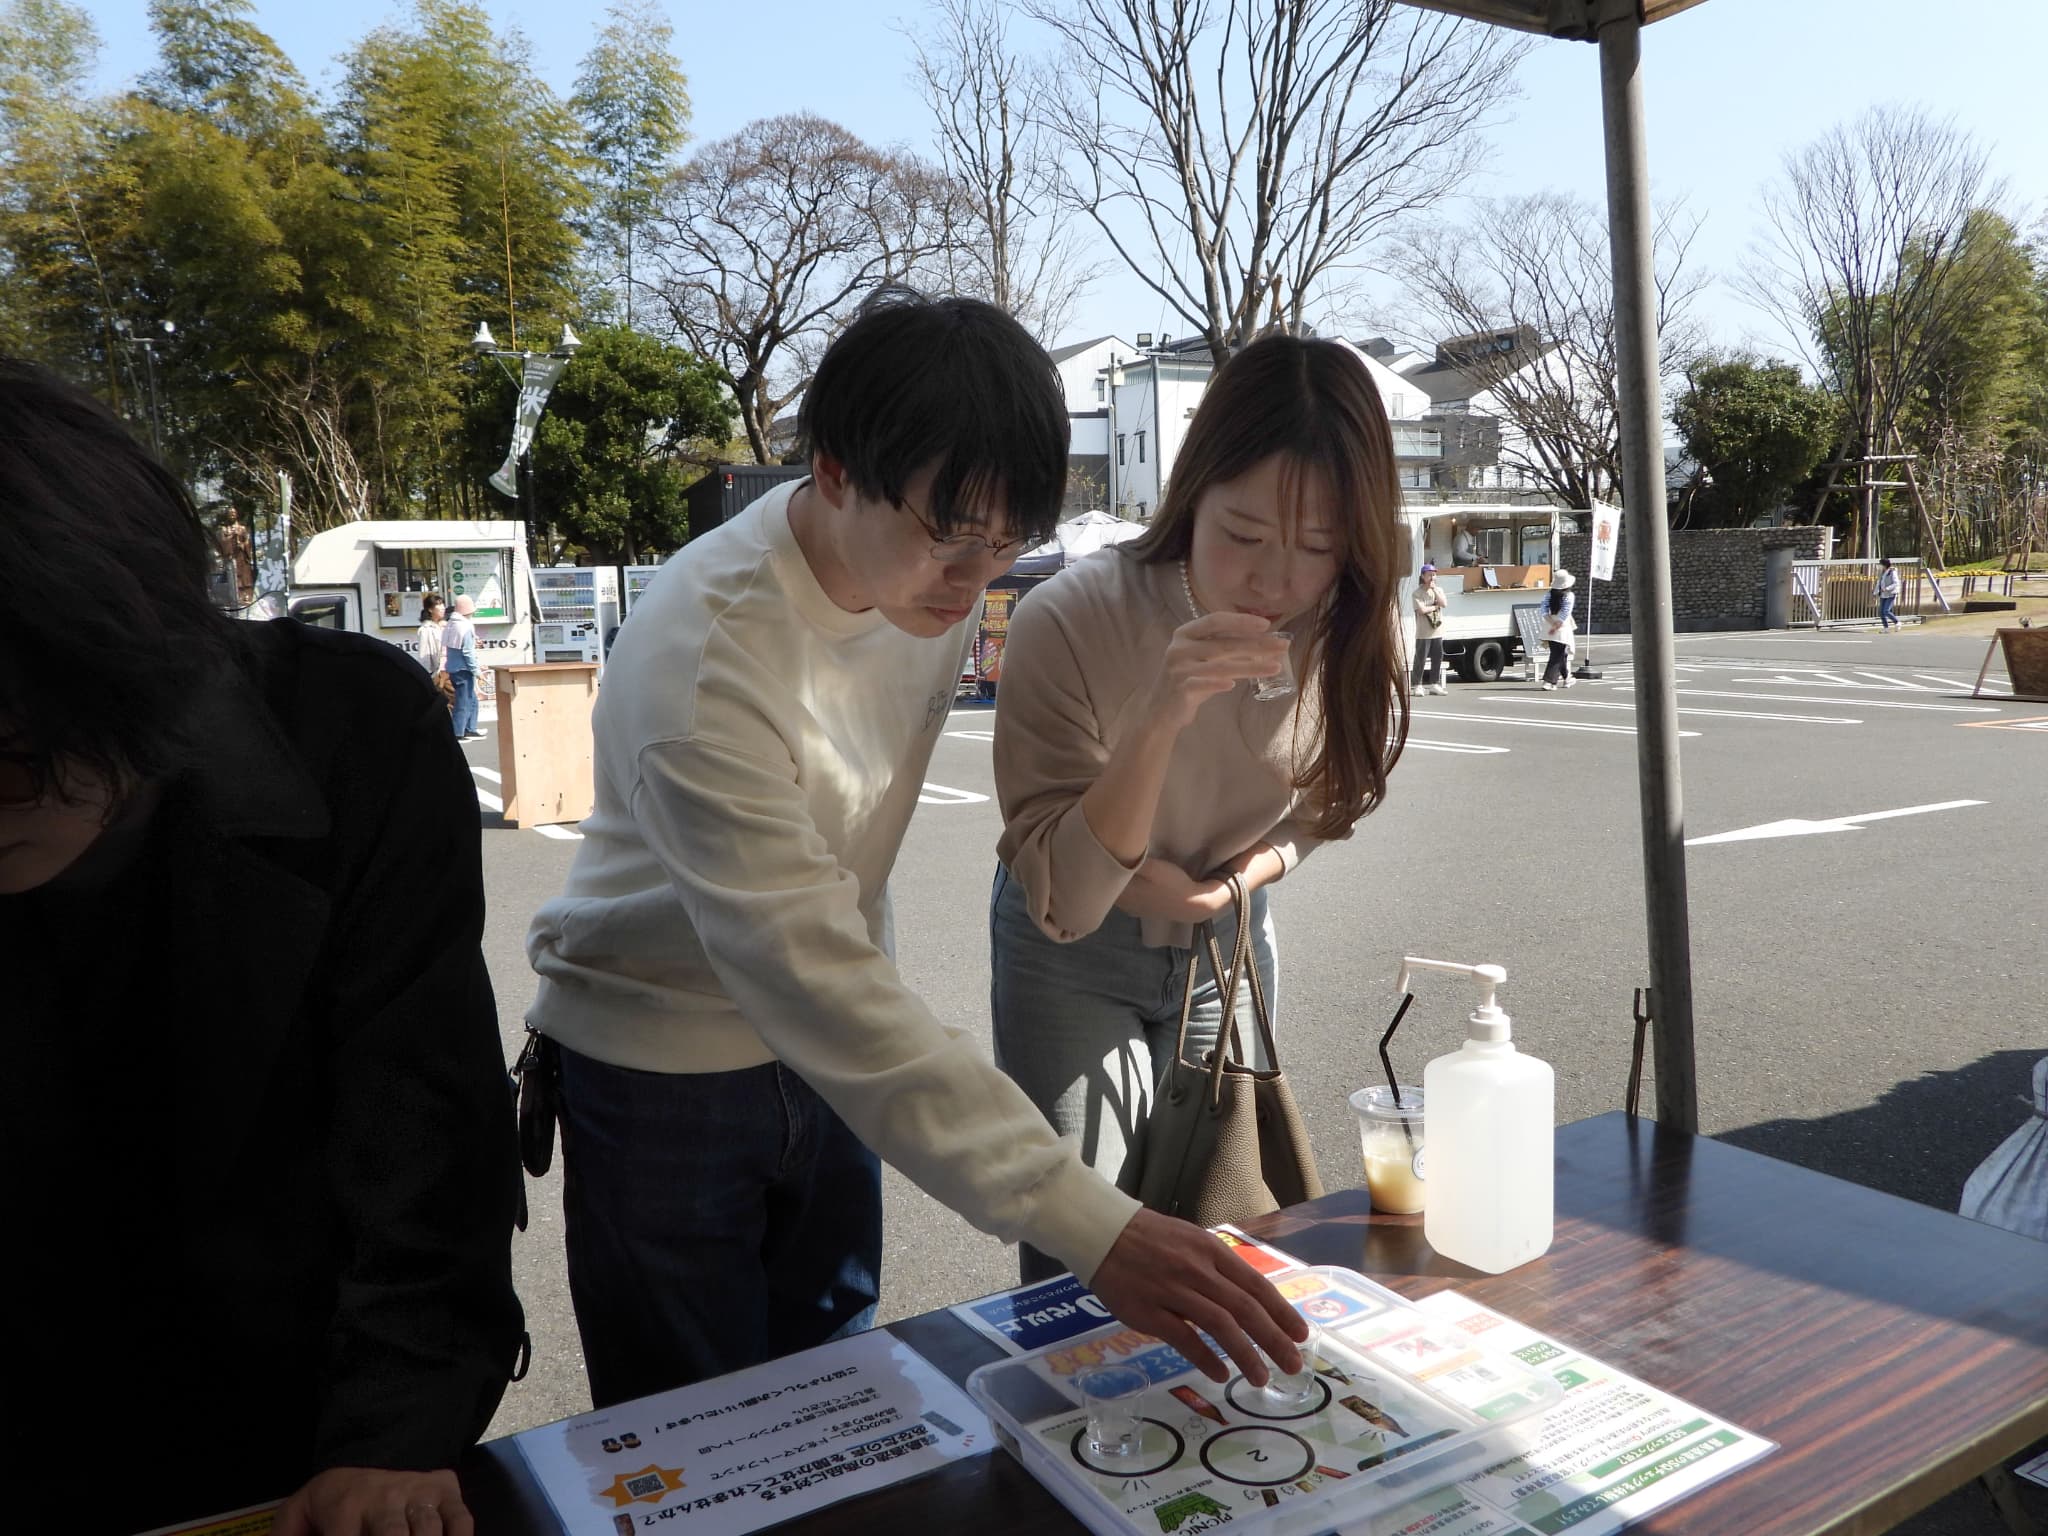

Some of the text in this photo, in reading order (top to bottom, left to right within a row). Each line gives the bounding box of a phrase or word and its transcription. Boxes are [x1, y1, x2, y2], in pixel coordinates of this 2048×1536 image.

[996, 1294, 1111, 1332] 0代以上
[1246, 1449, 1268, 1463] 2
